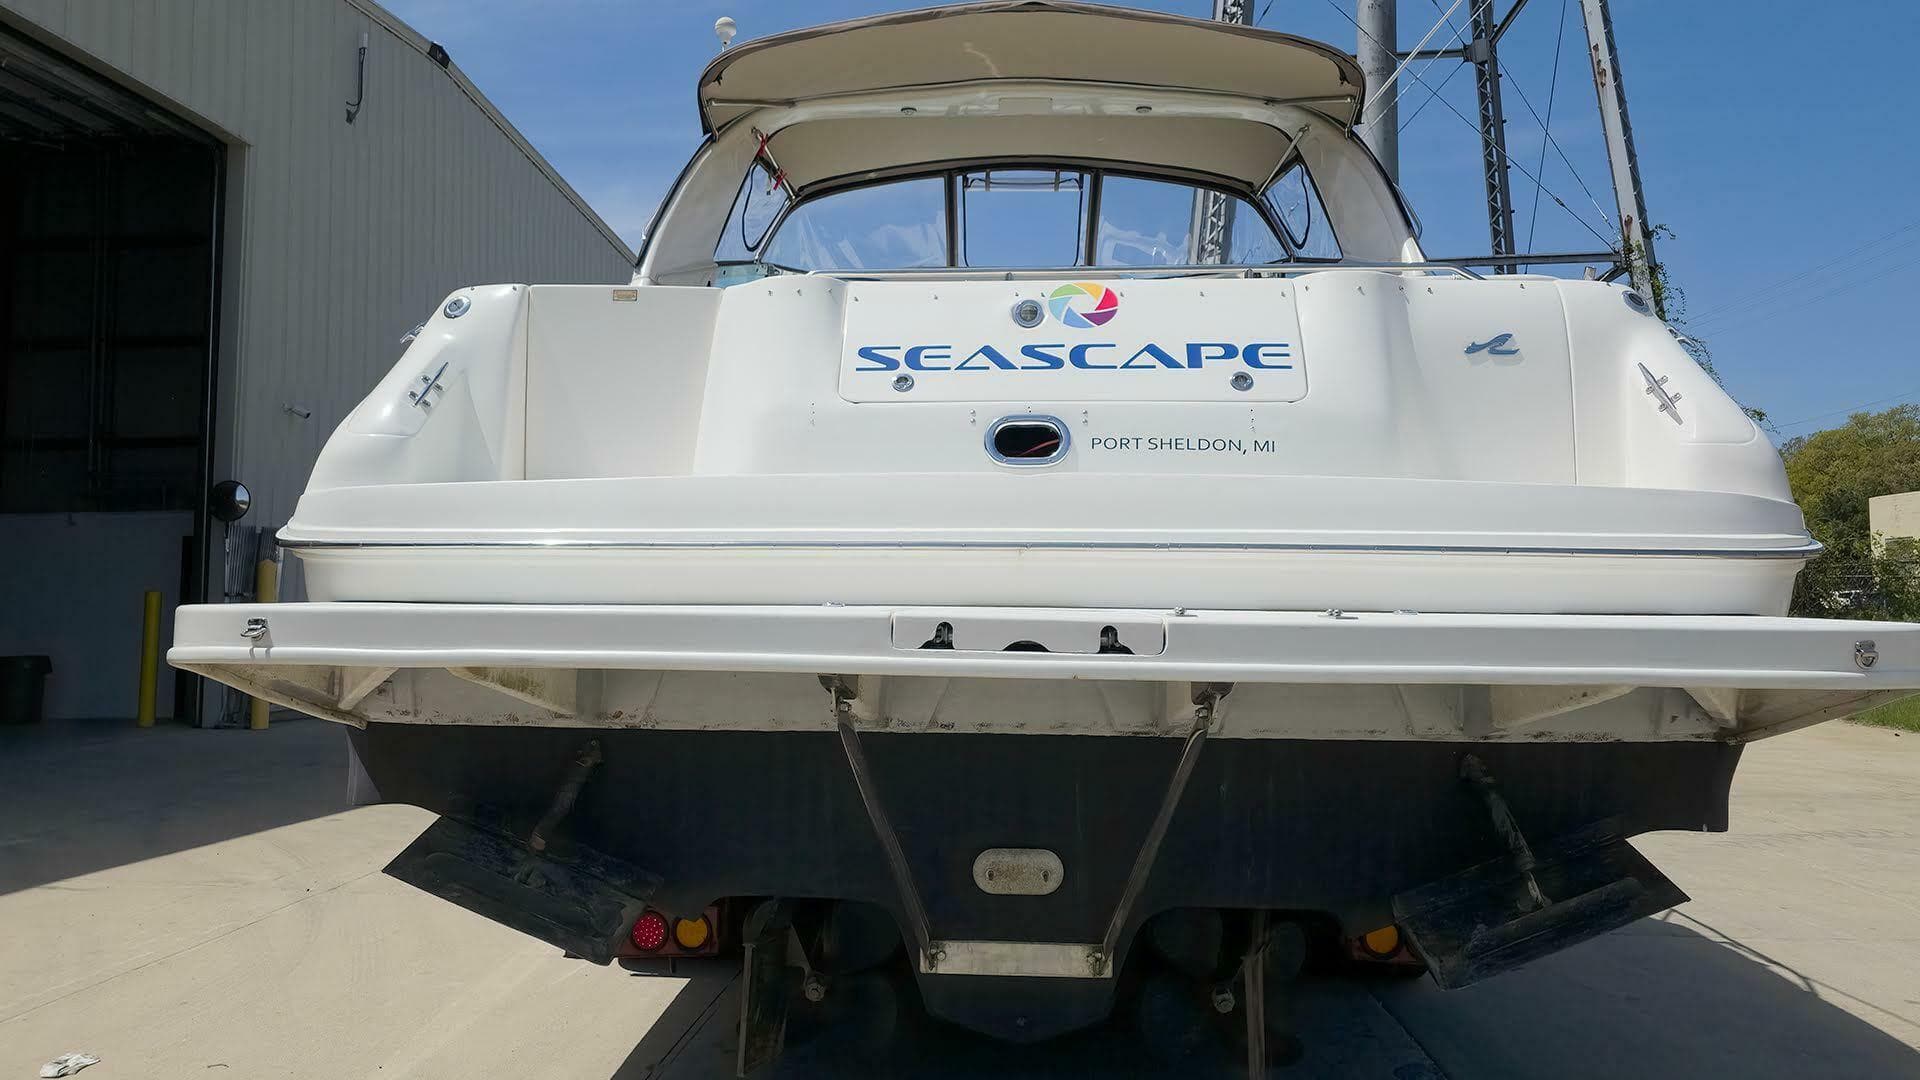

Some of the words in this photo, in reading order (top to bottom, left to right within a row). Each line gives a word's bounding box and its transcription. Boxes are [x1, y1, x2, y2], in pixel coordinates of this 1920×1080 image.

[855, 343, 1293, 370] SEASCAPE
[1091, 437, 1144, 450] PORT
[1147, 437, 1247, 455] SHELDON,
[1253, 439, 1275, 453] MI
